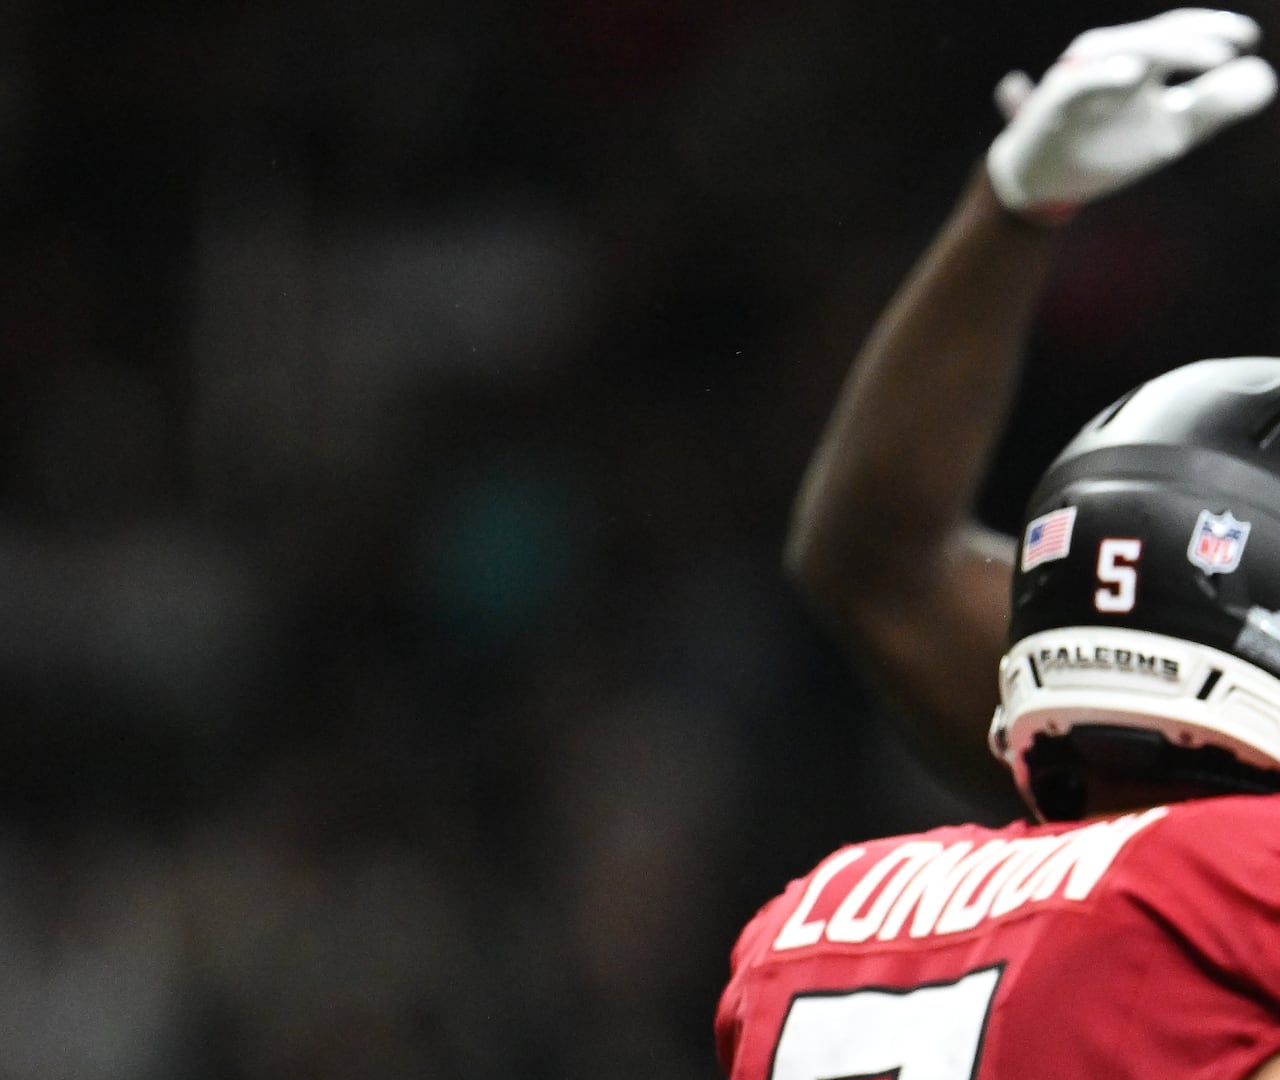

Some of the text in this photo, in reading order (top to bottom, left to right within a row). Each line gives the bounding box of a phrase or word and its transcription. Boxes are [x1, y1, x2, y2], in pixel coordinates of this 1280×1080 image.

[1093, 537, 1143, 614] 5
[1041, 646, 1180, 680] FALCONS
[773, 806, 1168, 950] LONDON
